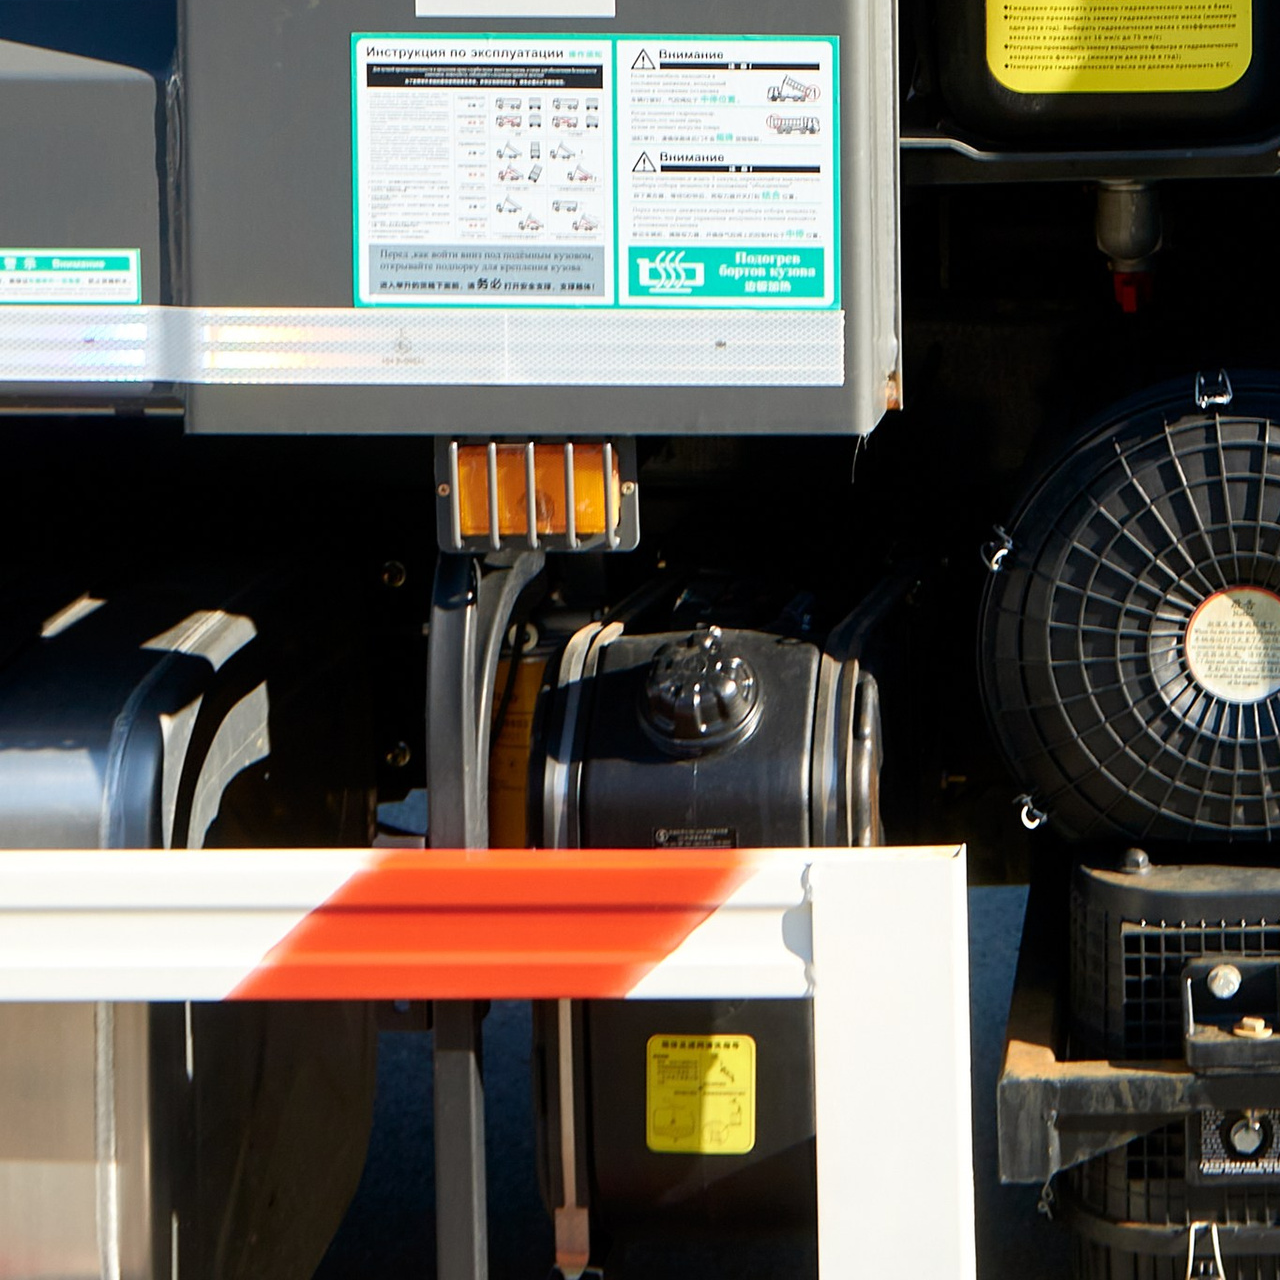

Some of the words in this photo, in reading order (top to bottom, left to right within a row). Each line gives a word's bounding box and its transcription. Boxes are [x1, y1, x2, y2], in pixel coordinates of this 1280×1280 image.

[367, 45, 446, 60] Инструкция
[450, 48, 466, 58] по
[471, 47, 564, 60] эксплуатации
[659, 48, 724, 60] Внимание
[660, 151, 725, 162] Внимание
[735, 251, 801, 267] Подогрев
[718, 264, 766, 280] бортов
[769, 267, 816, 280] кузова
